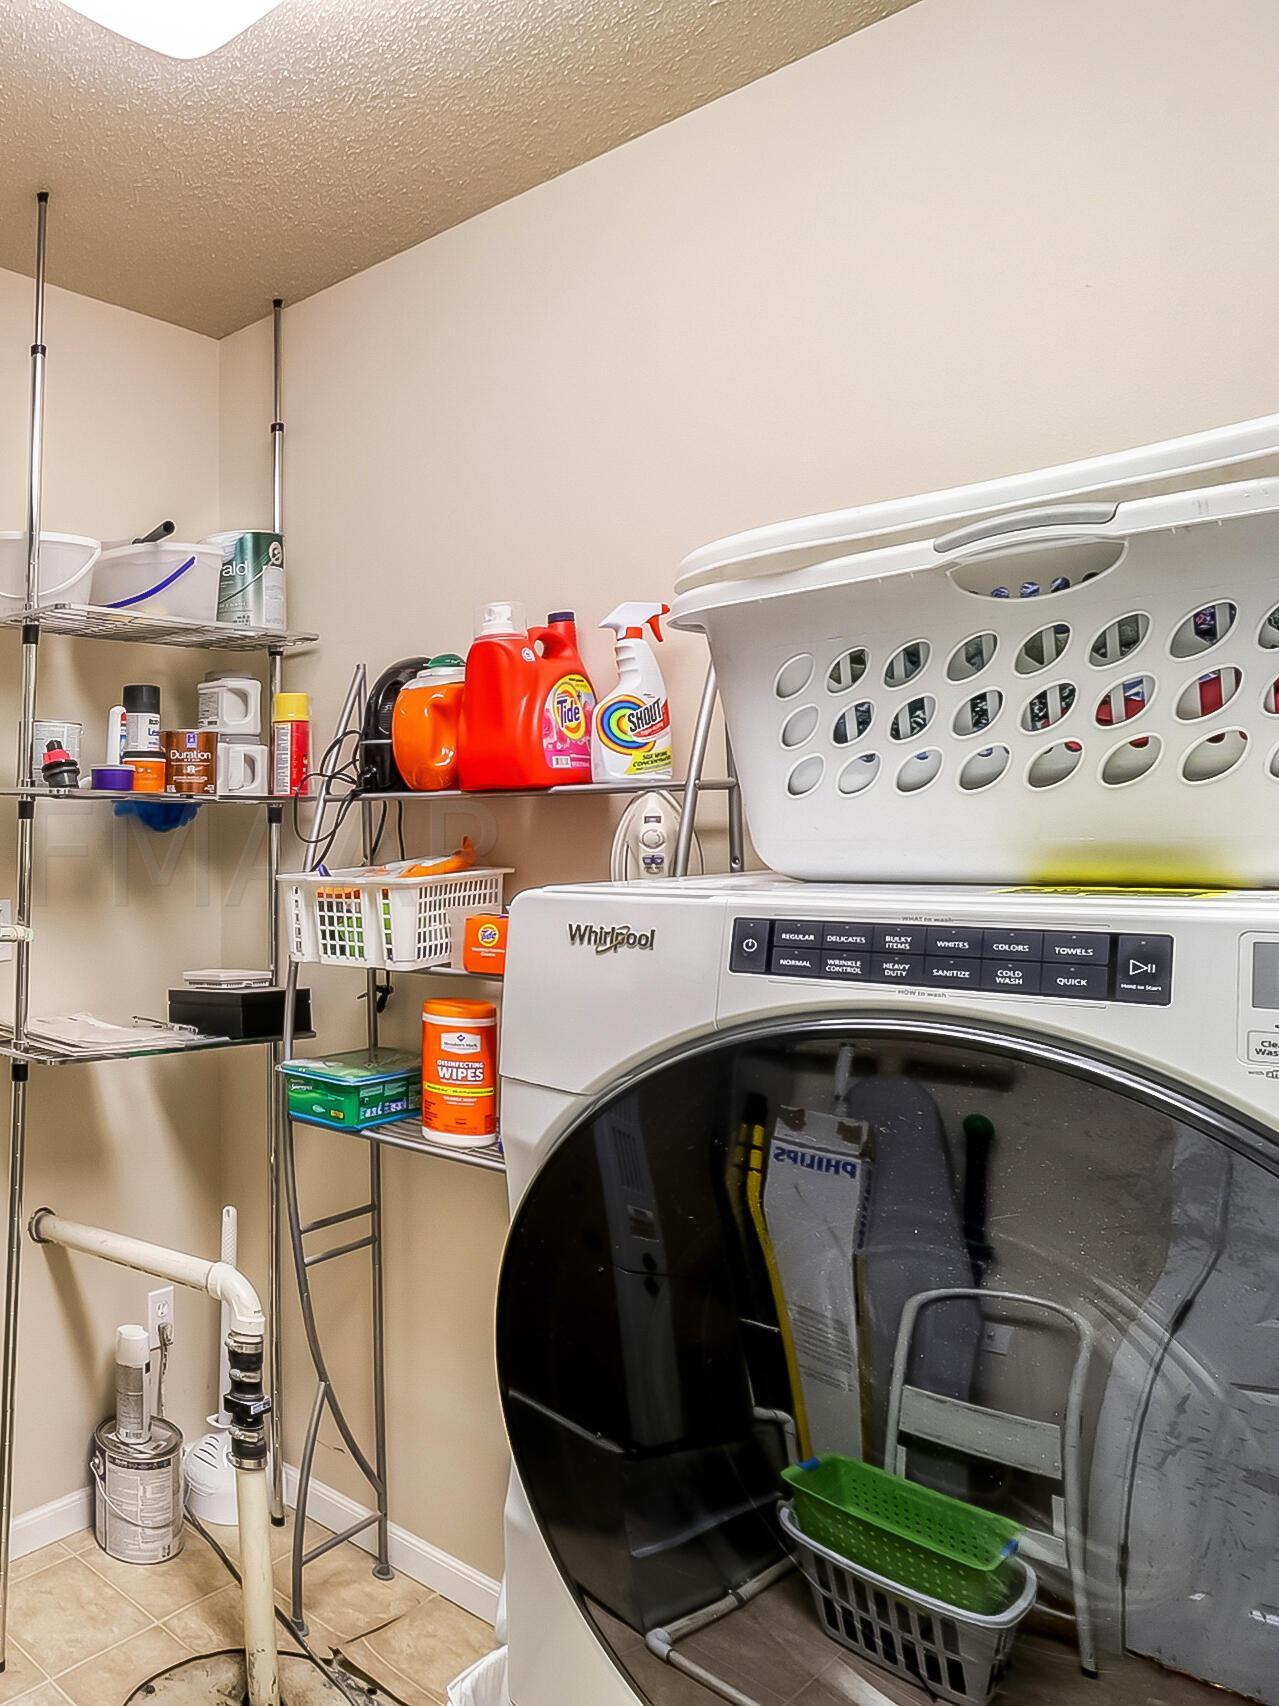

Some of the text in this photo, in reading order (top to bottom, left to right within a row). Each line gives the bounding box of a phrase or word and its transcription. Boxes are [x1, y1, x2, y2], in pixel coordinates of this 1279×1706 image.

[220, 560, 248, 577] ald
[557, 698, 580, 728] Tide
[628, 697, 661, 732] SHOUT
[568, 923, 656, 955] Whirlpool
[781, 933, 815, 941] REGULAR
[827, 935, 866, 944] DELICATES
[885, 935, 912, 943] BULKY
[936, 941, 969, 949] WHITES
[993, 943, 1030, 952] COLORS
[1054, 946, 1094, 956] TOWELS
[779, 959, 812, 968] NORMAL
[826, 959, 861, 967] WRINKLE
[882, 962, 911, 970] HEAVY
[825, 965, 863, 974] CONTROL
[884, 969, 908, 977] DUTY
[932, 969, 970, 978] SANITIZE
[997, 969, 1022, 977] COLD
[995, 976, 1023, 985] WASH
[1056, 977, 1088, 987] QUICK
[1260, 1040, 1279, 1049] Cle
[437, 1060, 484, 1069] DISINFECTING
[438, 1067, 484, 1081] WIPES
